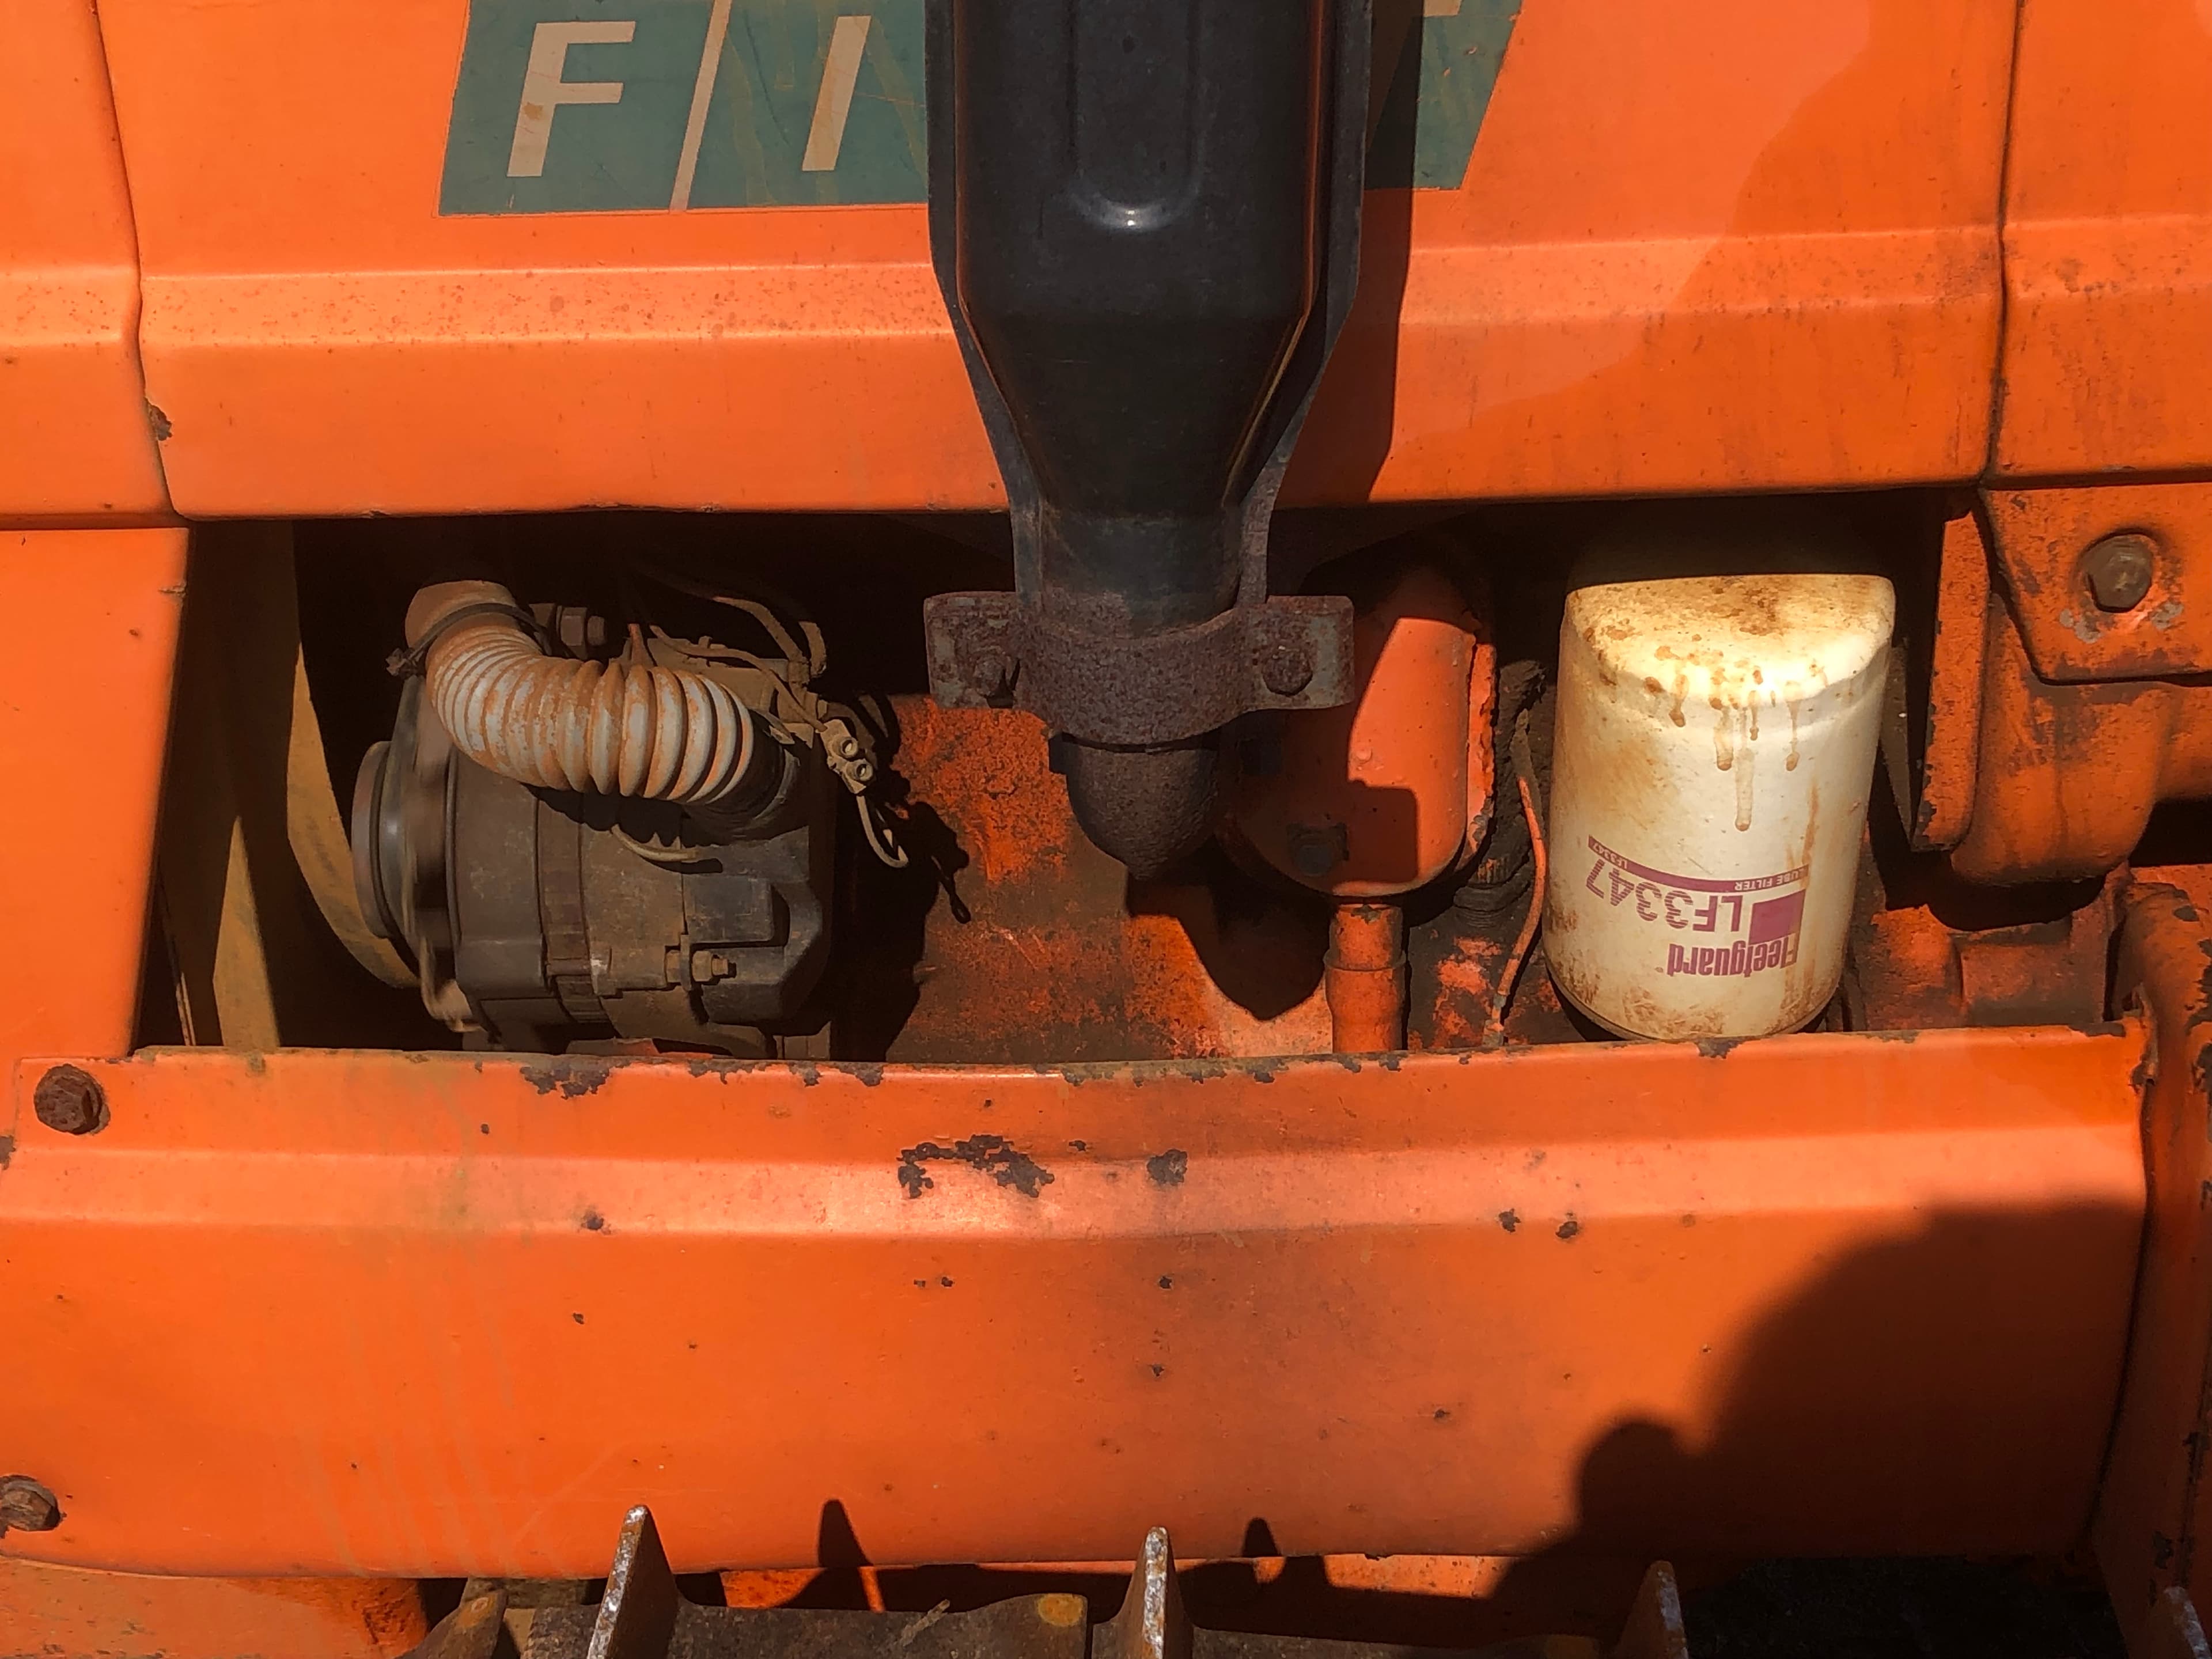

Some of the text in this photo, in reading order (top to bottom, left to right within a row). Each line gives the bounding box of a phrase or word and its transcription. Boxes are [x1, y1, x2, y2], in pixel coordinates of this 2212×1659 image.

[1593, 842, 1627, 869] LF3347
[1586, 858, 1743, 932] LF3347
[1734, 877, 1772, 891] FILTER
[1667, 934, 1797, 978] Fleetguard
